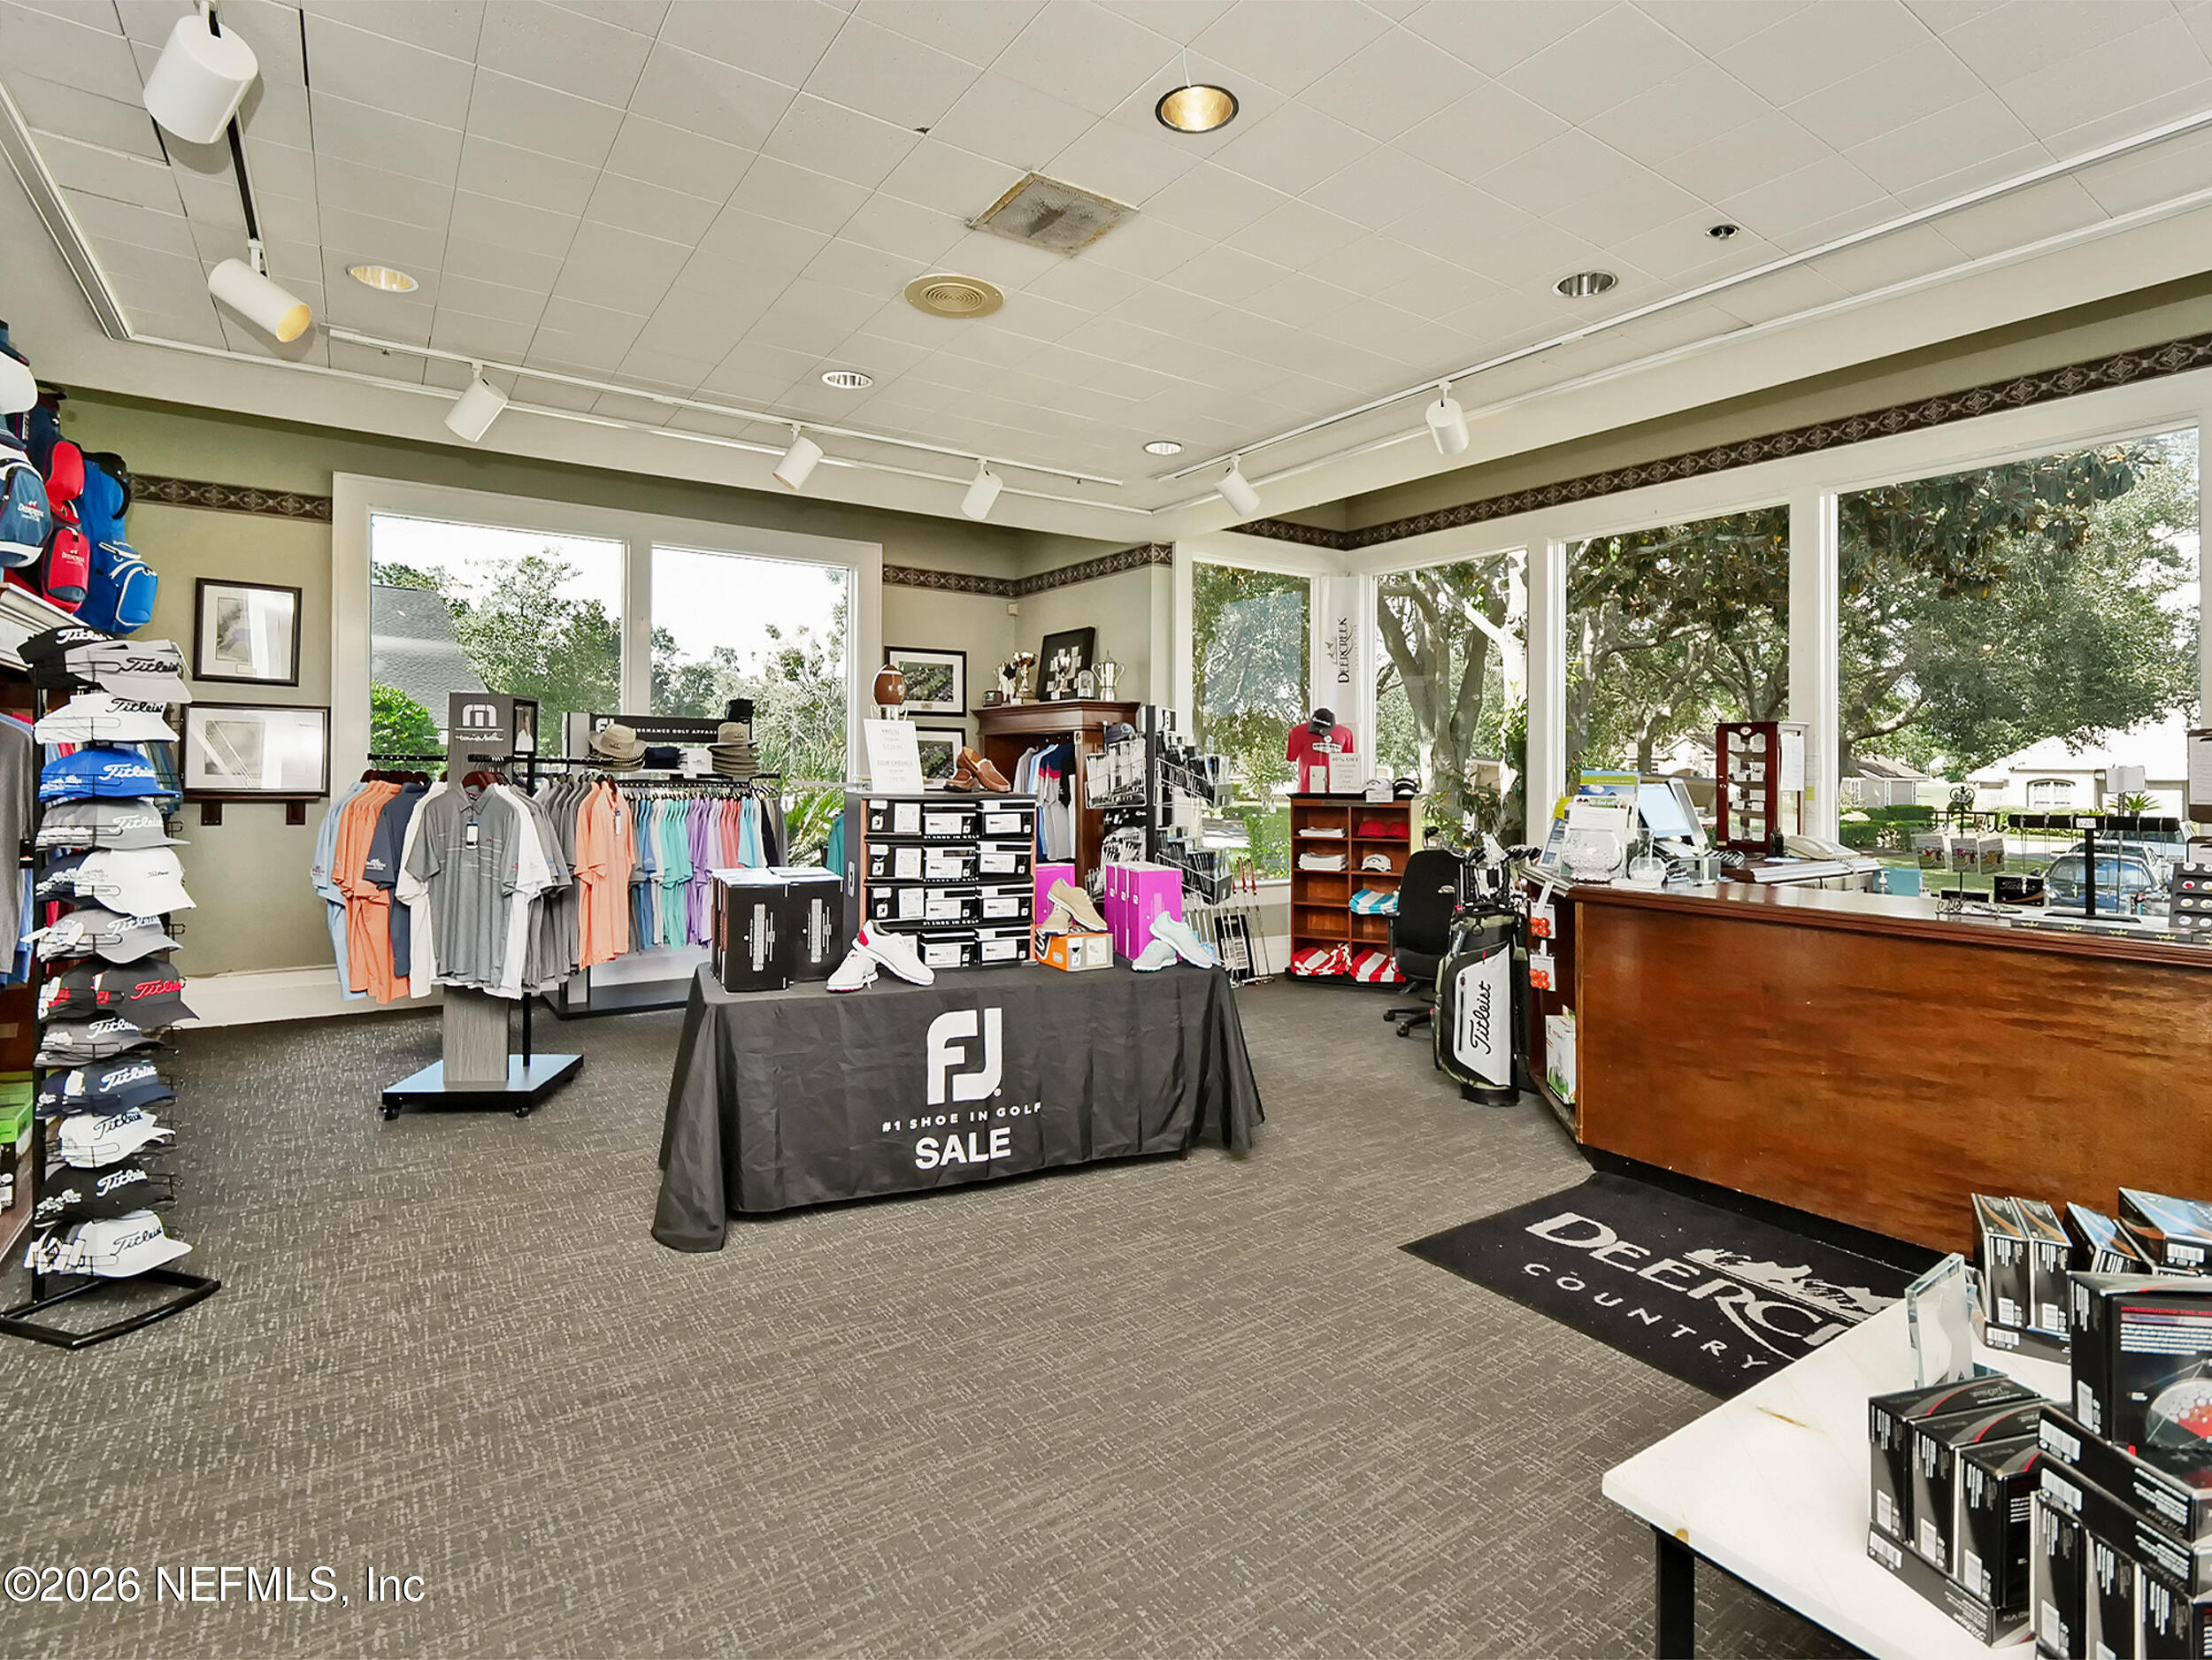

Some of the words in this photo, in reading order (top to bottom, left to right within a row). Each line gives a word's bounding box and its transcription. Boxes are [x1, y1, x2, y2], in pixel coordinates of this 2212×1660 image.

[926, 1007, 1002, 1105] FJ
[1470, 980, 1492, 1055] Titleist
[882, 1120, 902, 1133] #1
[910, 1113, 959, 1129] SHOE
[970, 1111, 988, 1122] IN
[996, 1102, 1041, 1118] GOLF
[915, 1126, 1011, 1170] SALE
[1524, 1262, 1769, 1369] COUNTRY
[1525, 1211, 1853, 1361] DEERC
